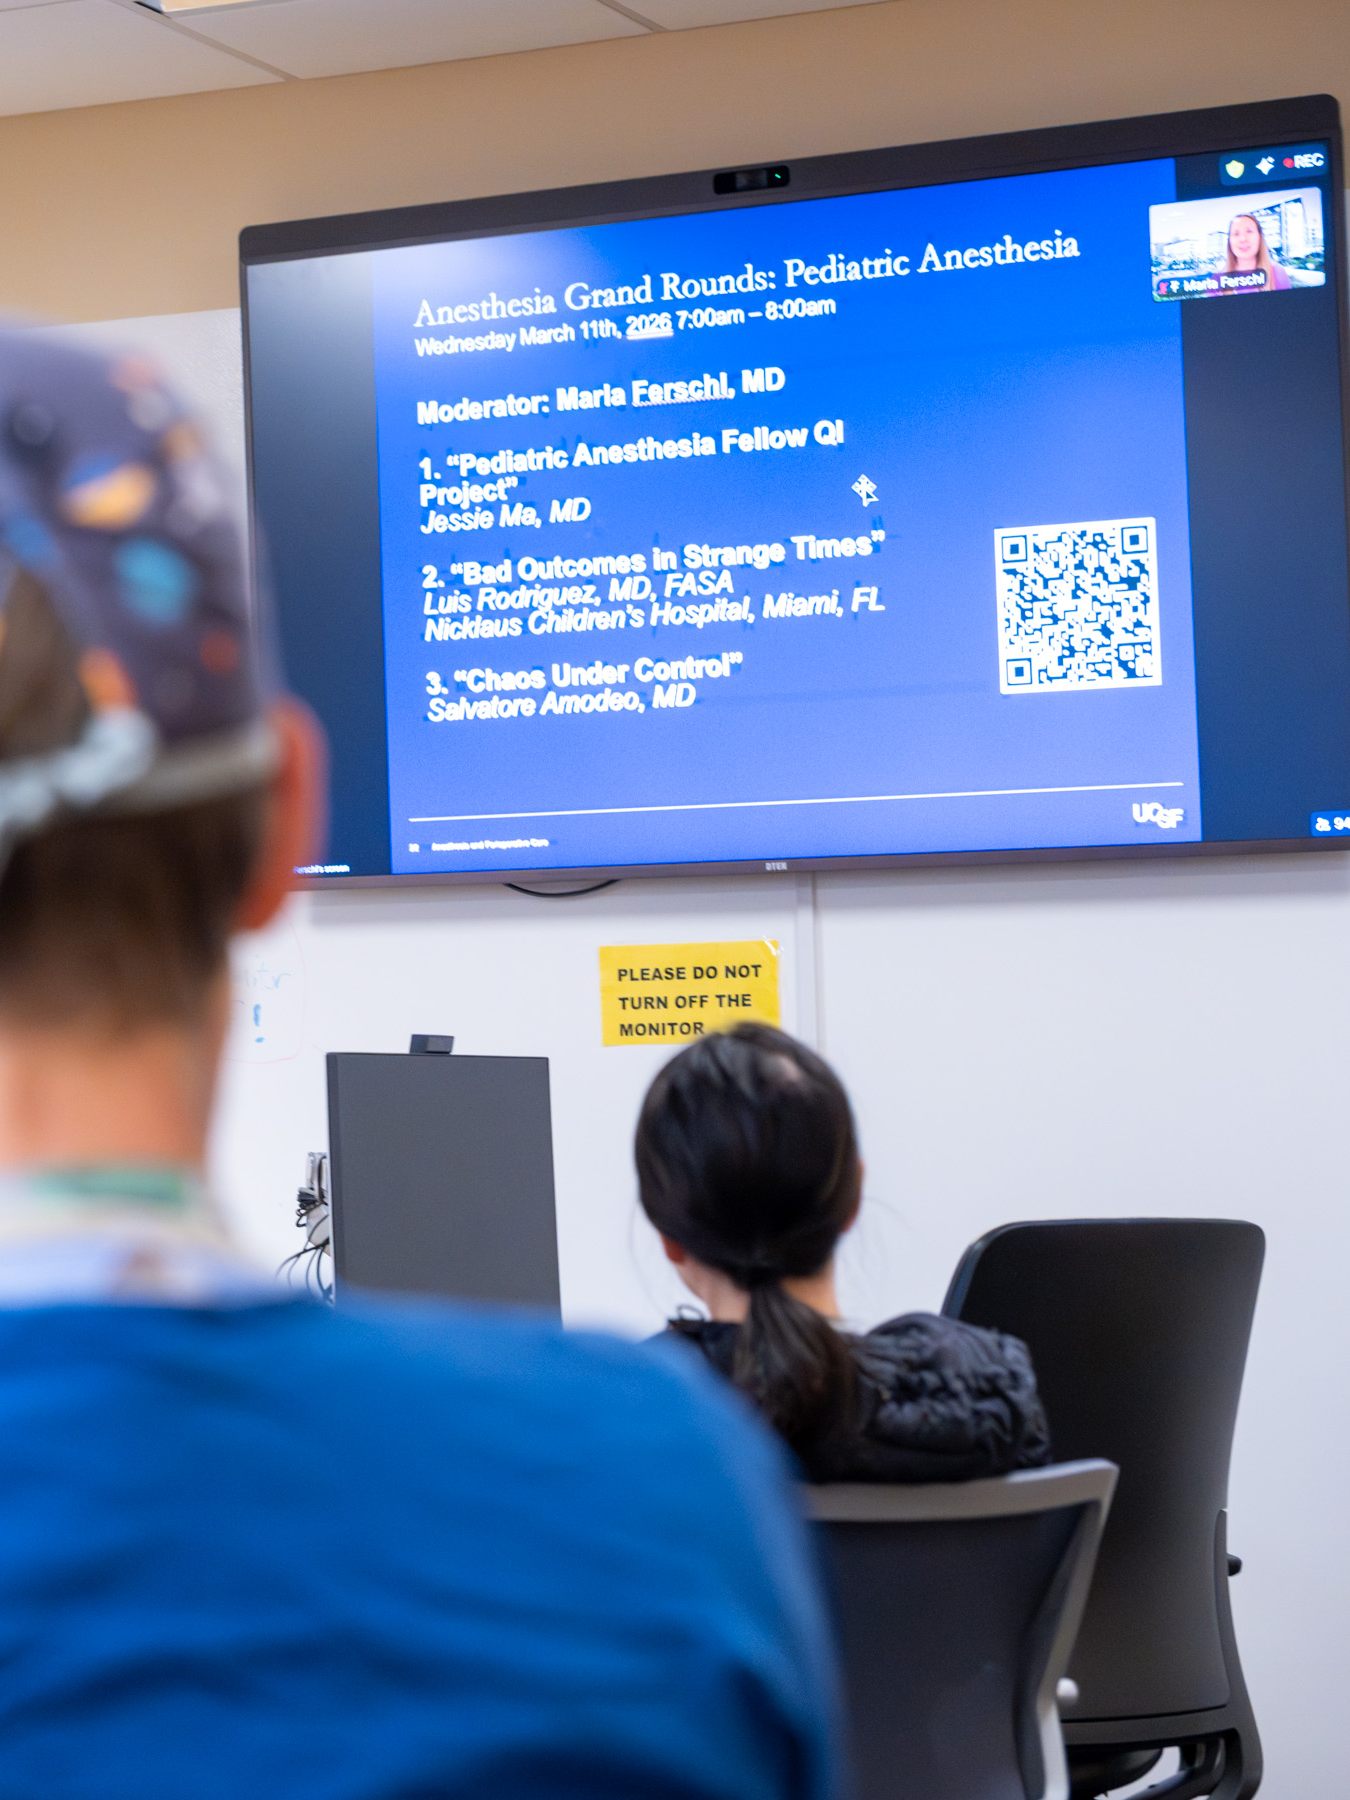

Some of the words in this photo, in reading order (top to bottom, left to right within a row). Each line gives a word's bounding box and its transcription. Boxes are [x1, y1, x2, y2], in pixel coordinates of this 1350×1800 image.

[1293, 152, 1325, 169] REC
[413, 288, 557, 327] Anesthesia
[564, 274, 654, 310] Grand
[660, 263, 777, 301] Rounds:
[783, 248, 911, 288] Pediatric
[916, 229, 1081, 274] Anesthesia
[415, 330, 516, 357] Wednesday
[519, 323, 575, 346] March
[580, 318, 623, 340] 11th,
[626, 312, 674, 339] 2026
[676, 306, 746, 330] 7:00am
[765, 297, 837, 322] 8:00am
[416, 393, 550, 426] Moderator:
[631, 372, 736, 407] Ferschl,
[741, 366, 786, 394] MD
[419, 456, 442, 480] 1.
[572, 433, 716, 467] Anesthesia
[721, 425, 809, 453] Fellow
[813, 418, 845, 447] QI
[420, 506, 496, 535] Jessie
[499, 500, 543, 528] Ma,
[548, 496, 592, 524] MD
[421, 564, 445, 590] 2.
[517, 550, 647, 582] Outcomes
[652, 546, 678, 571] in
[682, 538, 787, 570] Strange
[423, 591, 473, 616] Luis
[476, 582, 602, 614] Rodriguez,
[607, 574, 658, 604] MD,
[663, 569, 734, 599] FASA
[423, 613, 523, 643] Nicklaus
[649, 595, 756, 630] Hospital,
[761, 588, 845, 620] Miami,
[850, 586, 886, 613] FL
[425, 671, 450, 696] 3.
[551, 659, 631, 688] Under
[427, 695, 536, 723] Salvatore
[539, 686, 648, 716] Amodeo,
[651, 682, 697, 709] MD
[1132, 802, 1184, 829] UCSF
[617, 967, 686, 982] PLEASE
[692, 965, 718, 980] DO
[725, 964, 762, 979] NOT
[618, 996, 668, 1010] TURN
[675, 994, 709, 1009] OFF
[715, 993, 752, 1008] THE
[619, 1022, 705, 1037] MONITOR
